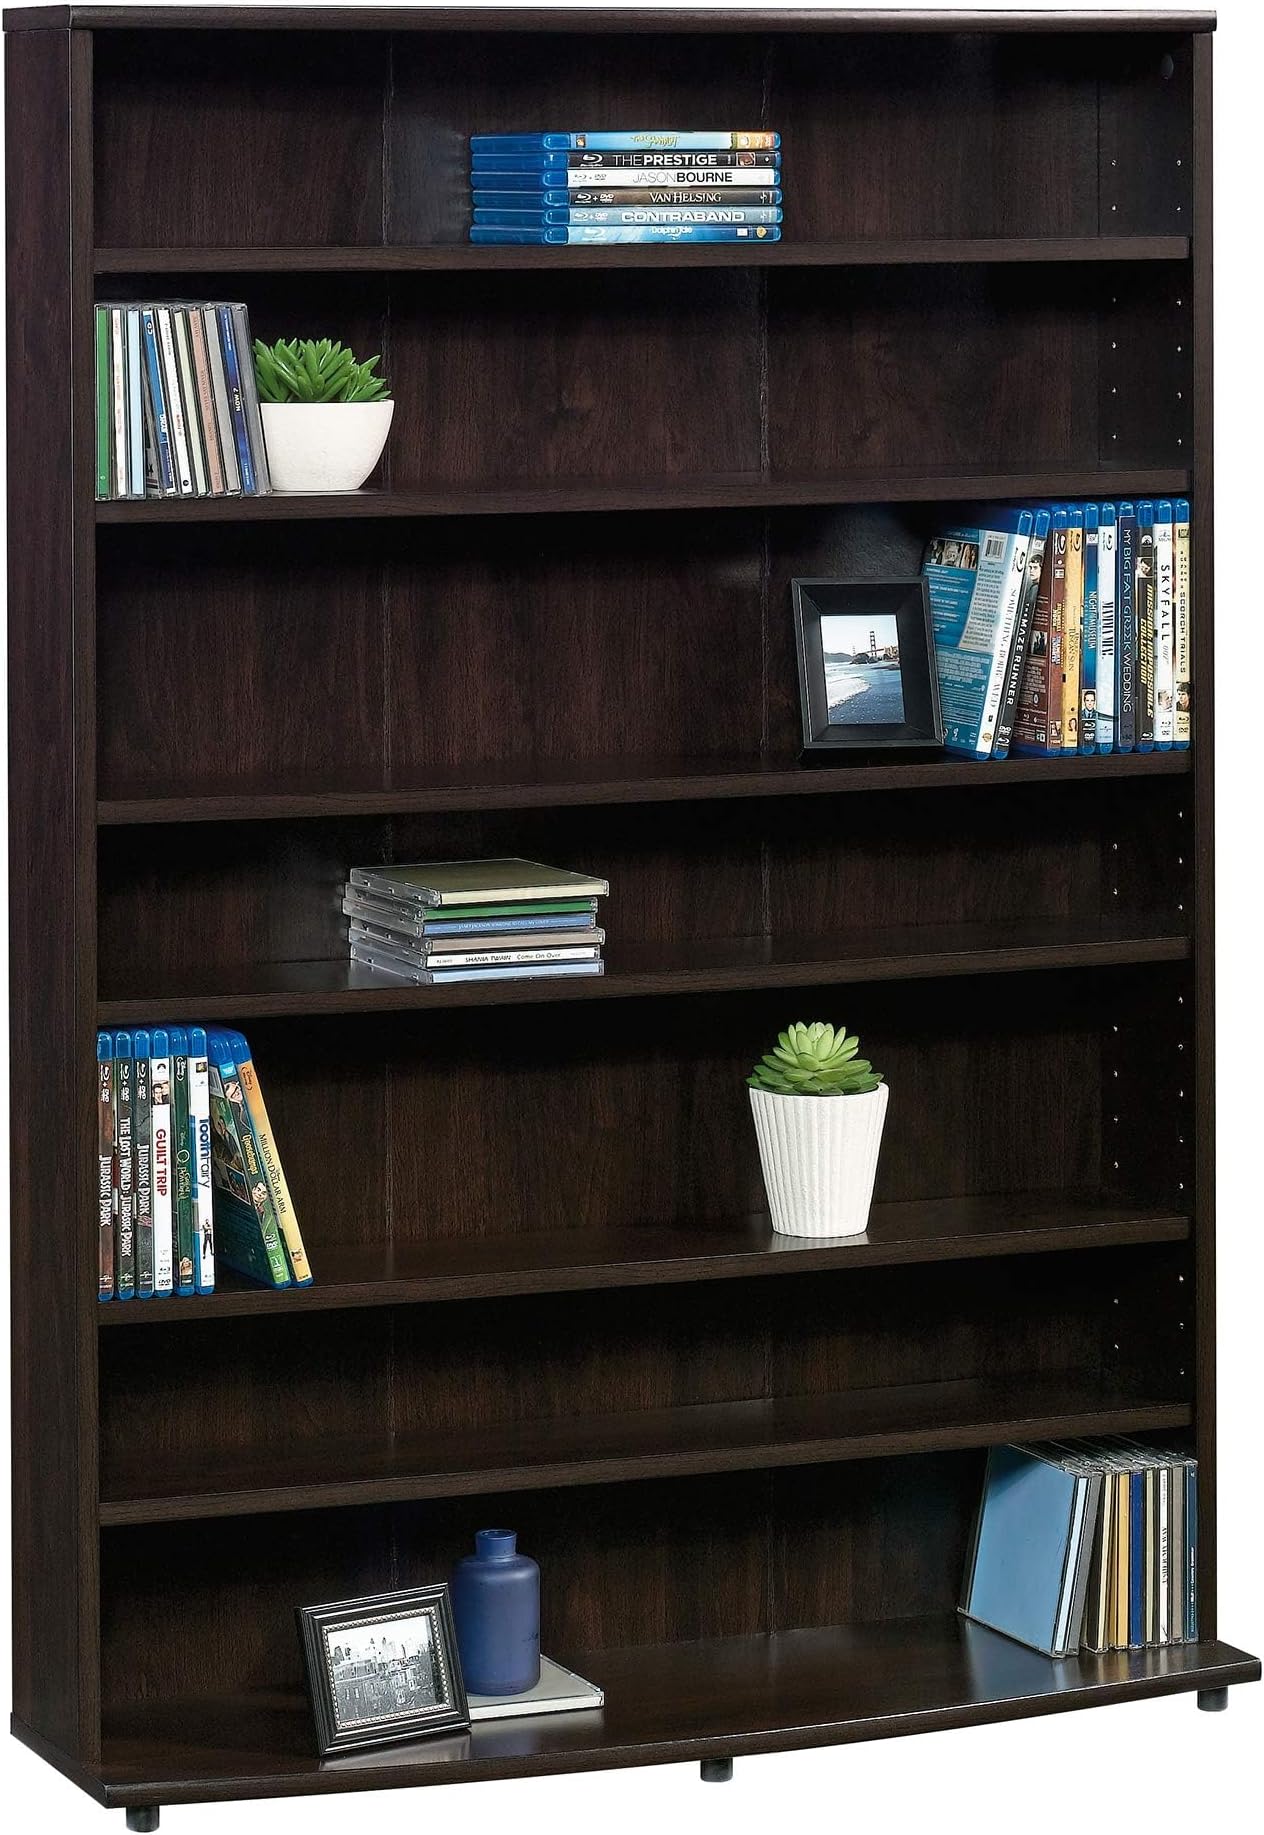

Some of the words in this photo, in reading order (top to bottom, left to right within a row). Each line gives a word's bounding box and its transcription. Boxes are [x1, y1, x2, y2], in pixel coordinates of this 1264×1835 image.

[650, 192, 671, 202] VAN
[672, 192, 722, 204] HELSING
[621, 211, 745, 222] CONTRABAND
[147, 322, 152, 334] CD
[1123, 529, 1131, 546] MY
[1123, 546, 1131, 570] BIG
[1088, 591, 1097, 612] NIGHT
[1123, 572, 1131, 603] FAT
[1161, 564, 1170, 640] SKYFALL
[1088, 618, 1096, 649] MUSEUM
[1102, 602, 1113, 634] MAMMA
[1016, 618, 1030, 652] MAZE
[1006, 656, 1023, 706] RUNNER
[1123, 653, 1132, 712] WEDDING
[120, 1117, 131, 1135] THE
[120, 1136, 131, 1157] LOST
[156, 1129, 167, 1166] GUILT
[241, 1134, 258, 1175] Goosebumps
[99, 1155, 112, 1198] JURASSIC
[137, 1144, 150, 1186] JURASSIC
[259, 1134, 274, 1164] MILLION
[267, 1164, 282, 1196] DOLLAR
[275, 1197, 287, 1214] ARM
[157, 1168, 167, 1196] TRIP
[100, 1199, 112, 1227] PARK
[121, 1195, 132, 1232] JURASSIC
[139, 1188, 151, 1215] PARK
[121, 1232, 132, 1256] PARK
